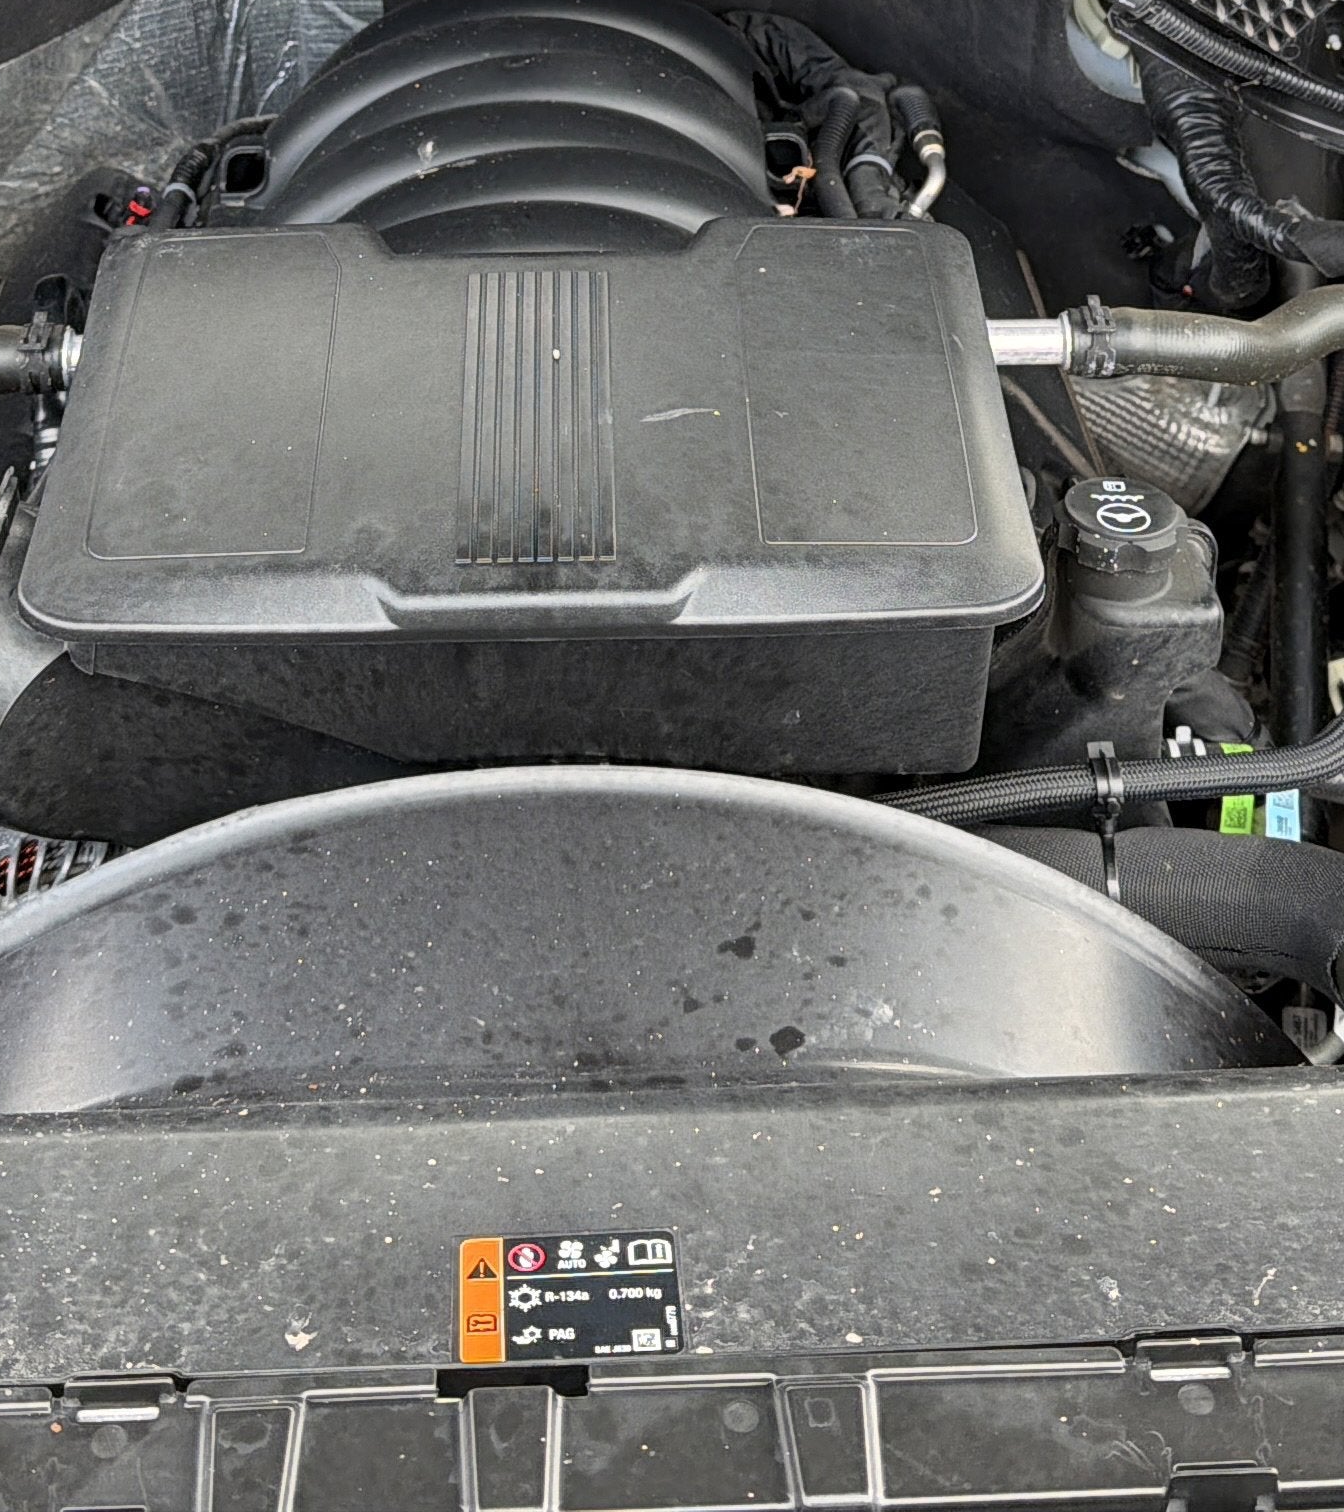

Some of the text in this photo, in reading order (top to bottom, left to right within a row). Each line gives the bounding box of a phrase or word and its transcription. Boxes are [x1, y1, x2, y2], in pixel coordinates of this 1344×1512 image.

[557, 1259, 586, 1269] AUTO
[545, 1290, 590, 1302] R-134a
[608, 1287, 663, 1300] 0.700 kg
[548, 1328, 575, 1340] PAG
